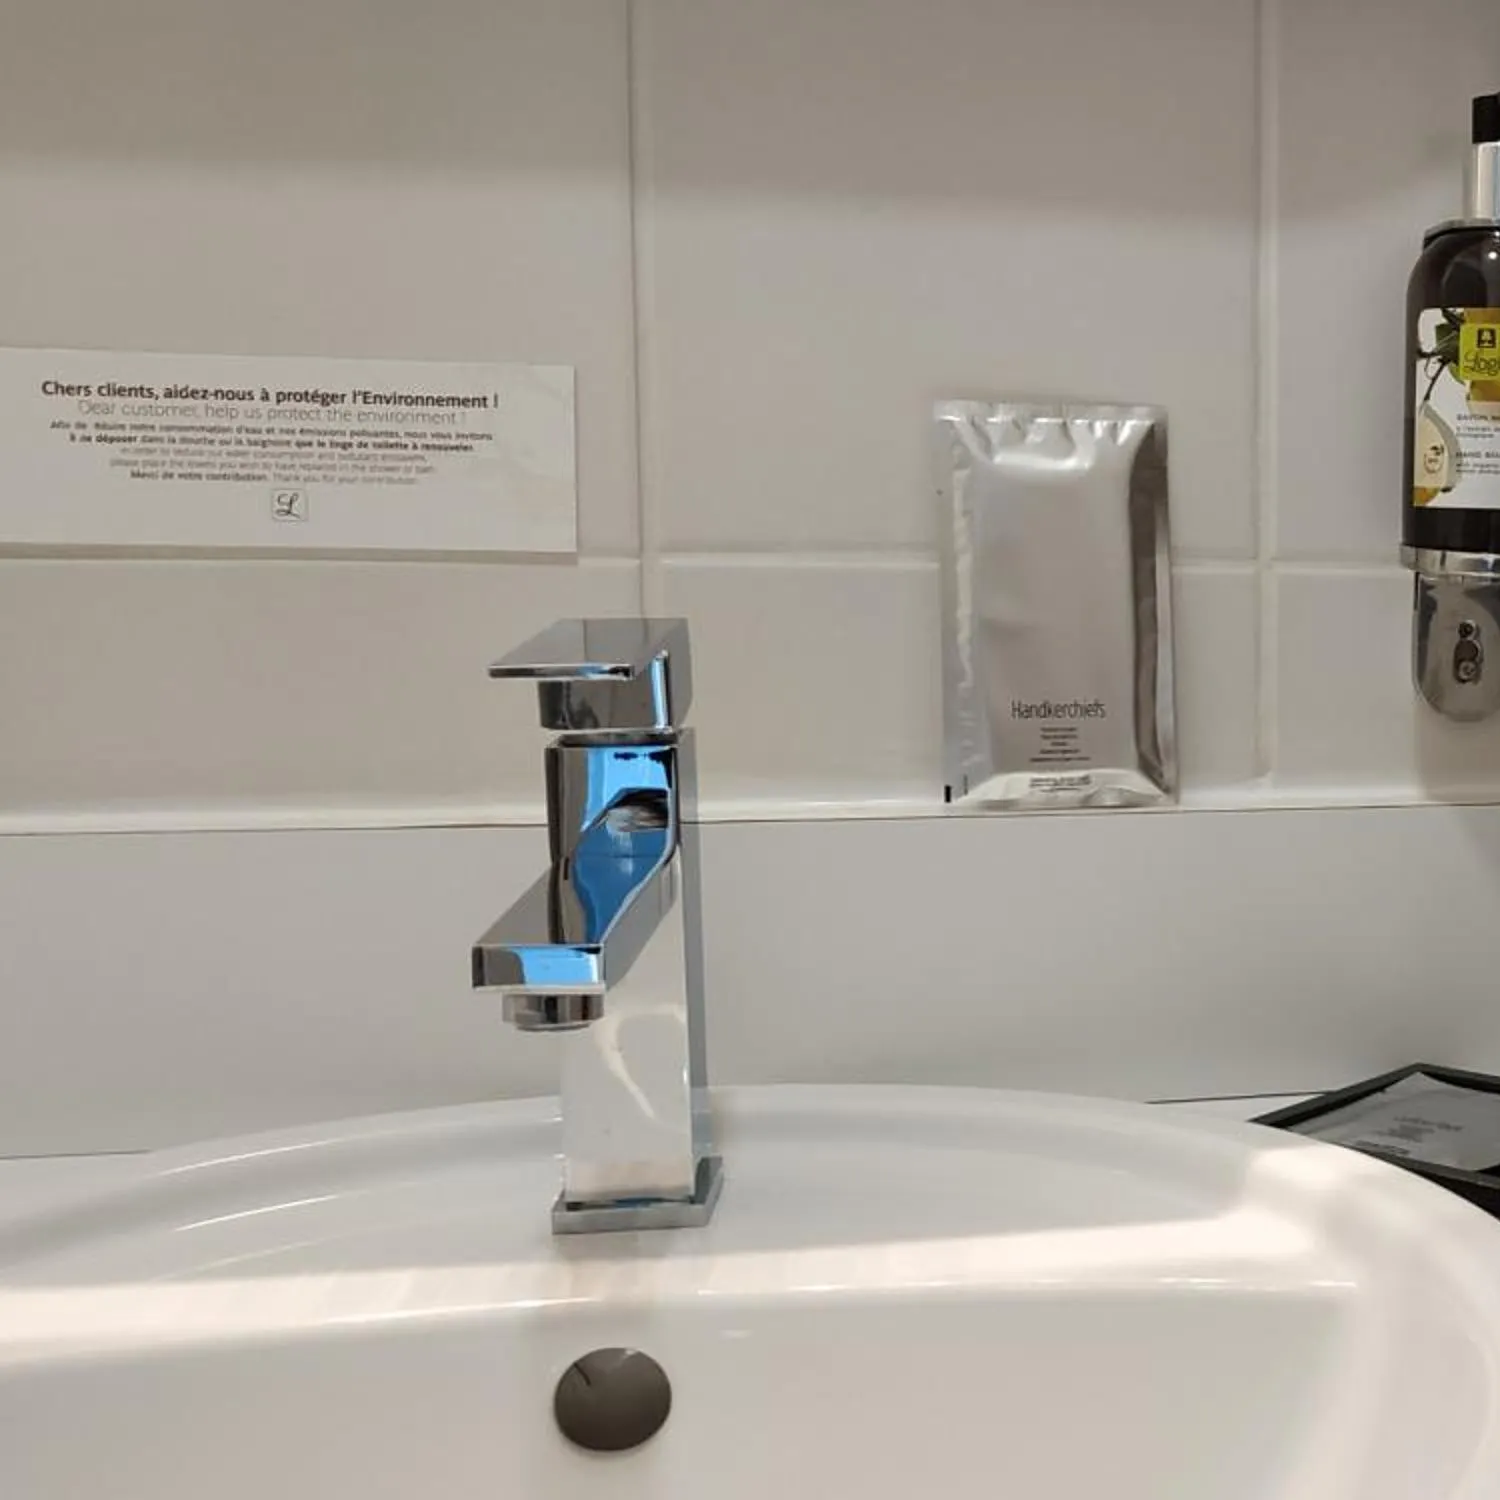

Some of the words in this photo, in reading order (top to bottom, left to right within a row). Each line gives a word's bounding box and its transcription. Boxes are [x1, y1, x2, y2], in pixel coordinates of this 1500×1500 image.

[41, 381, 92, 396] Chers
[97, 383, 159, 400] clients,
[164, 384, 255, 401] aidez-nous
[260, 387, 270, 401] à
[275, 389, 347, 406] protéger
[351, 390, 488, 408] l'Environnement
[78, 400, 115, 415] Dear
[205, 404, 239, 420] help
[244, 408, 262, 418] us
[267, 406, 321, 421] protect
[326, 408, 352, 422] the
[357, 410, 456, 424] environment
[1010, 699, 1106, 719] Handkerchiefs
